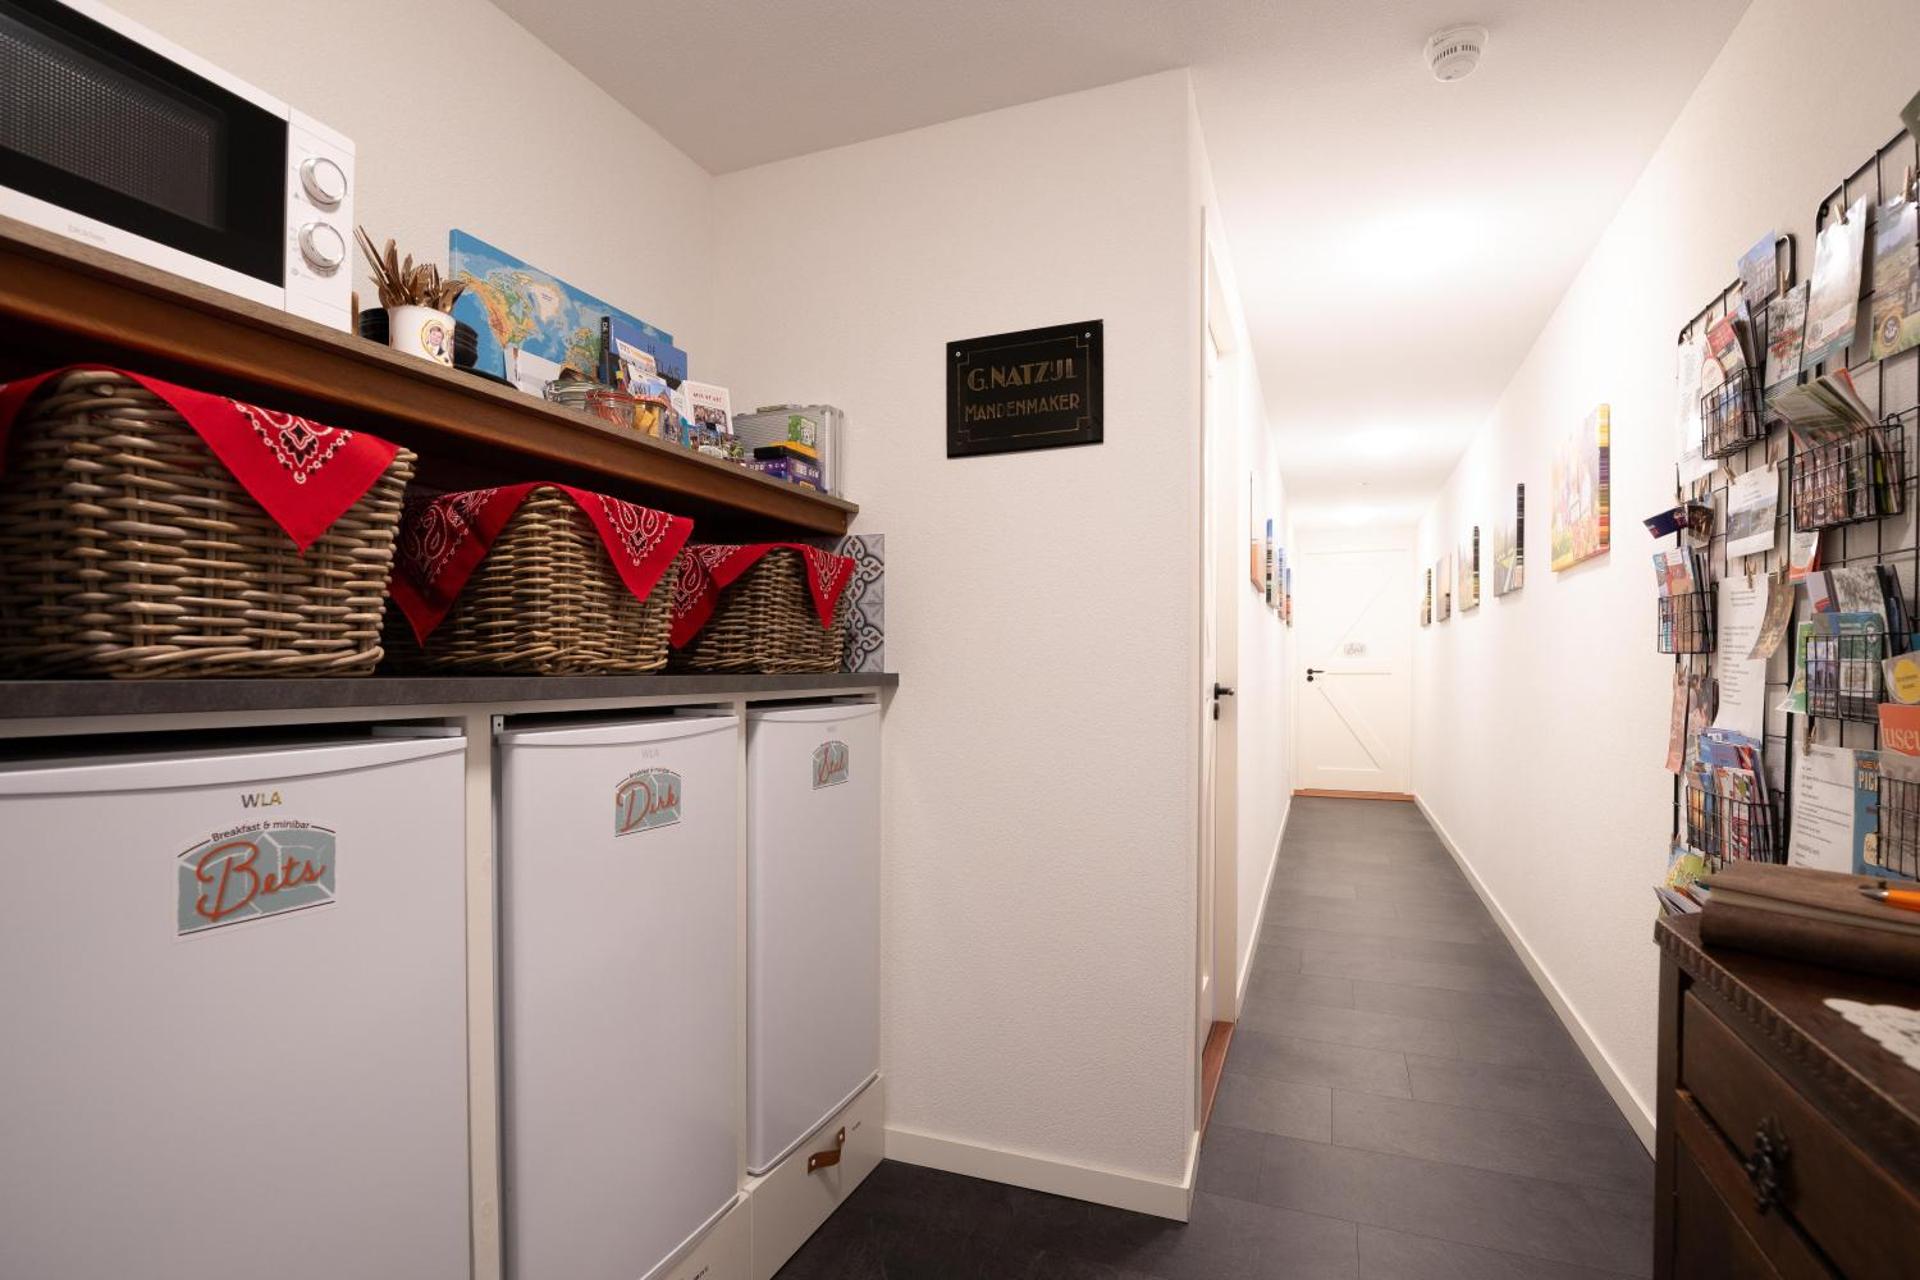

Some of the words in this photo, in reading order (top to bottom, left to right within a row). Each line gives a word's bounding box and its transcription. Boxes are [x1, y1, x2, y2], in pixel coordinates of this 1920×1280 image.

[964, 393, 1081, 423] MANDENMAKER
[241, 792, 282, 808] WLA
[211, 822, 261, 842] Breakfast
[263, 821, 271, 829] &
[273, 820, 311, 830] minibar
[195, 841, 326, 923] Bets
